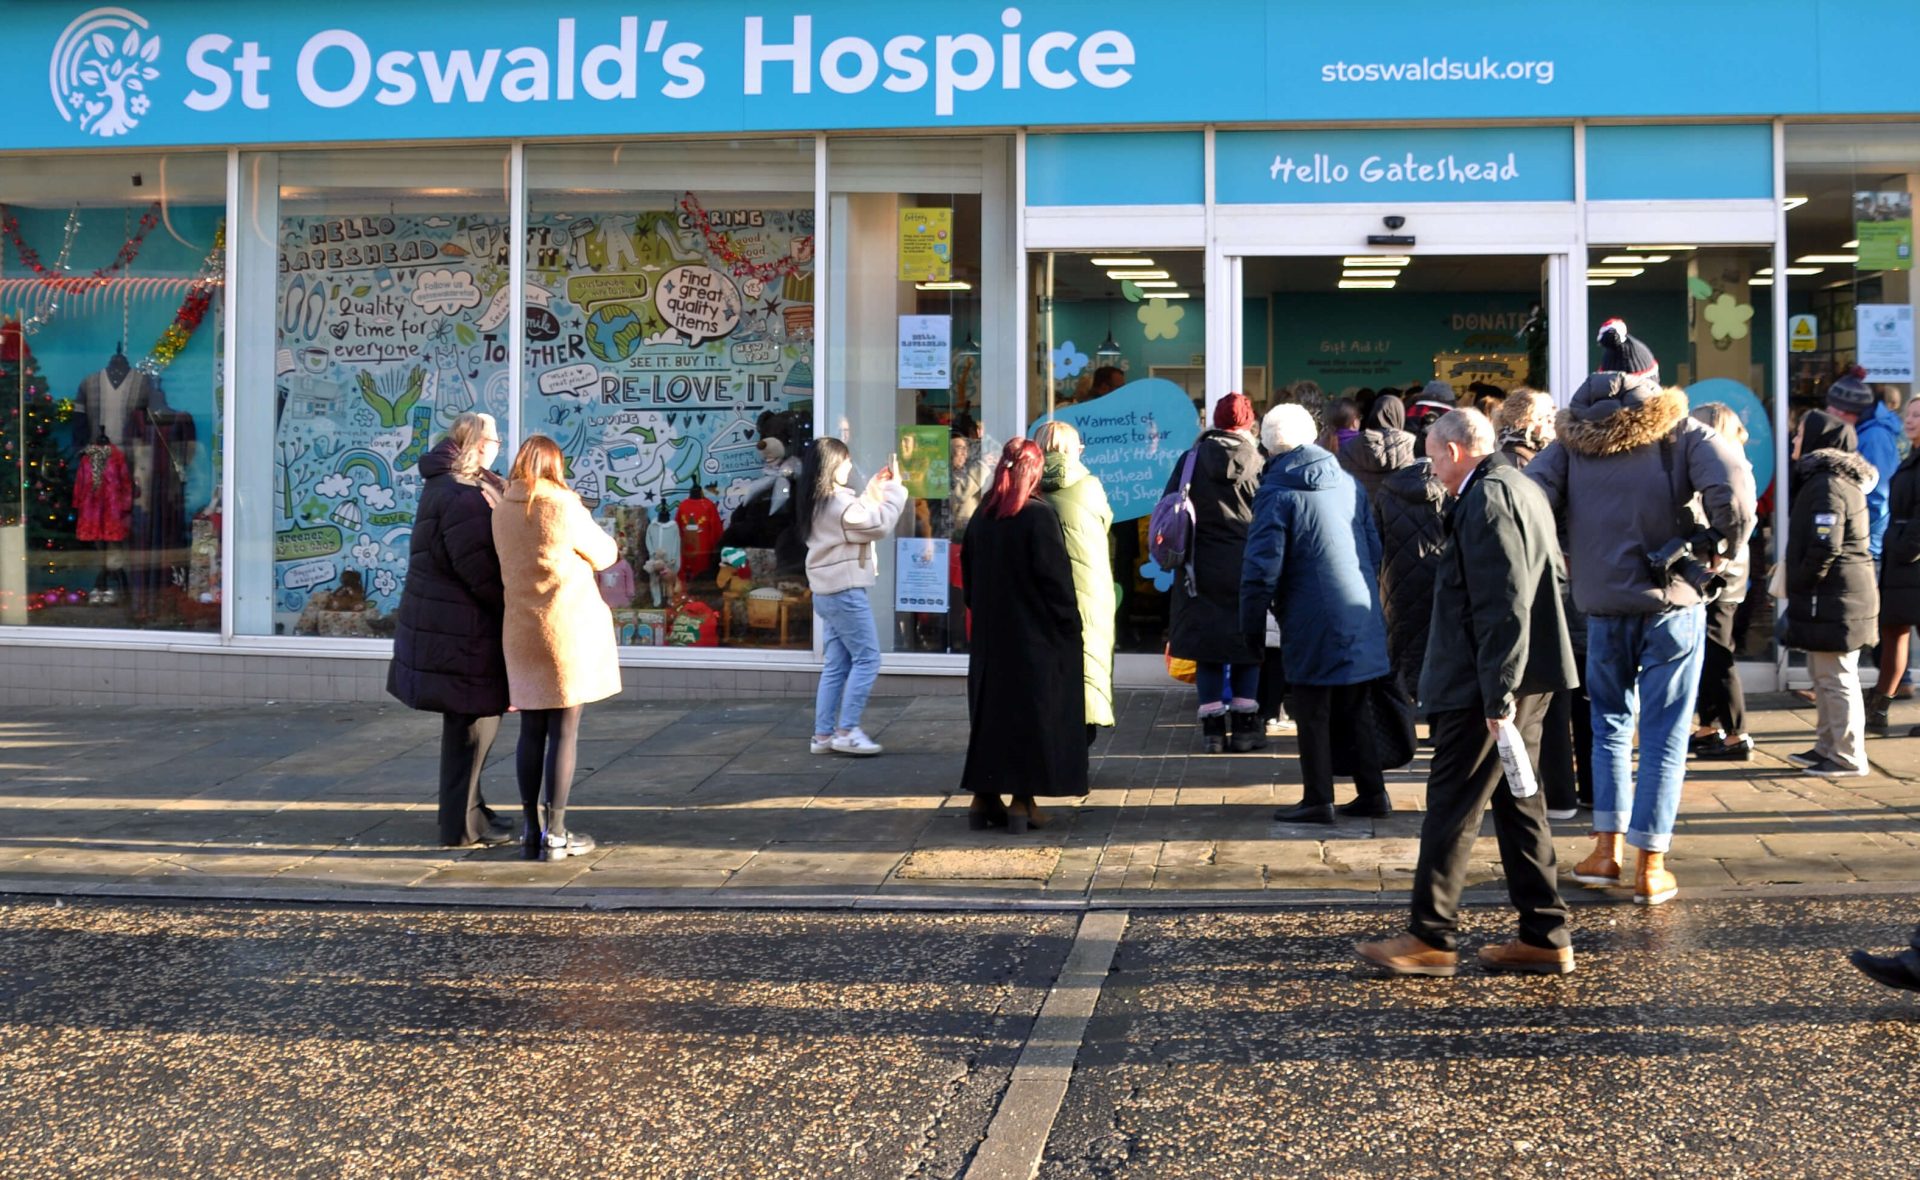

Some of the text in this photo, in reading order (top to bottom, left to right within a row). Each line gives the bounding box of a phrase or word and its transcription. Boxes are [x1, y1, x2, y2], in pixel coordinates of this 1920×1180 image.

[184, 8, 1135, 116] St Oswald's Hospice
[1321, 56, 1554, 84] stoswaldsuk.org
[1270, 153, 1519, 183] Hello Gateshead
[677, 210, 765, 229] CRING
[309, 217, 396, 245] HELLO
[680, 269, 711, 288] Find
[679, 285, 723, 302] great
[339, 295, 404, 320] Quality
[667, 299, 719, 318] quality
[355, 319, 427, 341] time for
[676, 315, 718, 333] items
[334, 342, 420, 365] everyone
[629, 358, 652, 368] SEE
[675, 356, 699, 367] BUY
[601, 374, 779, 404] RE-LOVE IT.
[588, 412, 639, 427] LOVING
[1075, 411, 1154, 427] Warmest of
[1079, 430, 1172, 446] lcomes to our
[1100, 467, 1153, 484] teshead
[374, 513, 406, 523] LOVE
